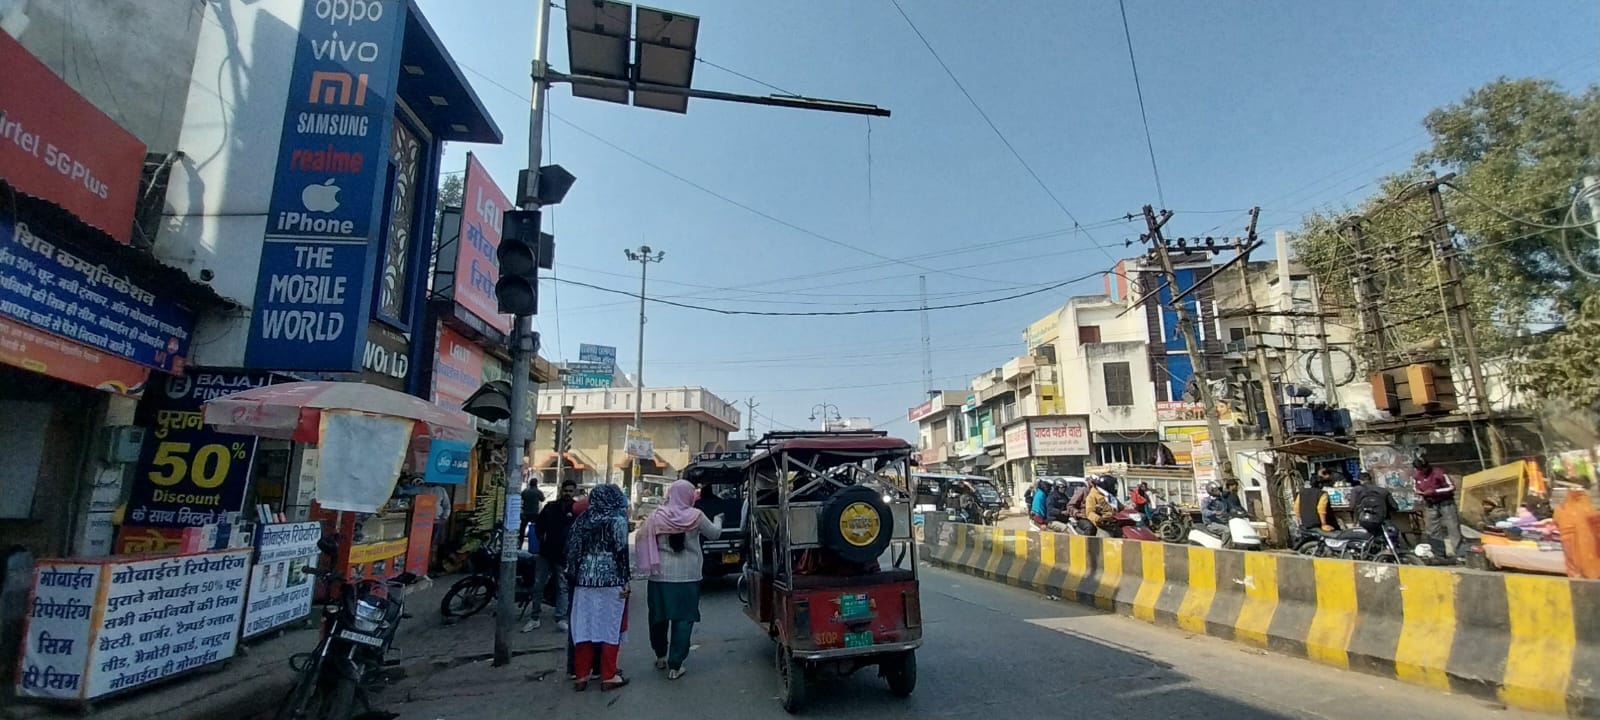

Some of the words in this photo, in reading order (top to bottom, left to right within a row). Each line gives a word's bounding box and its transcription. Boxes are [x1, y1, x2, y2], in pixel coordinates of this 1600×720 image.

[312, 31, 379, 62] vivo
[0, 109, 40, 158] irtel
[297, 112, 369, 137] SAMSUNG
[291, 144, 365, 175] realme
[278, 211, 354, 234] iPhone
[476, 186, 501, 235] LAL
[14, 221, 56, 259] शिव
[16, 256, 37, 277] 50%
[294, 245, 333, 269] THE
[268, 274, 347, 305] MOBILE
[31, 288, 47, 304] की
[66, 302, 78, 317] ही
[128, 324, 139, 340] ही
[51, 316, 62, 332] से
[261, 310, 344, 342] WORLD
[197, 373, 264, 388] BAJAJ
[567, 374, 584, 385] ELHI
[585, 376, 610, 388] POLICE
[1034, 426, 1051, 438] यादव
[1068, 422, 1082, 437] वाले
[152, 489, 221, 505] Discount
[132, 504, 148, 521] के
[149, 510, 174, 523] साथ
[177, 506, 214, 525] मिलते
[182, 555, 246, 576] रिपेयरिंग
[108, 589, 145, 612] पुराने
[201, 580, 223, 594] 50%
[226, 577, 243, 592] छूट
[32, 596, 92, 620] रिपेयरिंग
[104, 611, 136, 629] सभी
[138, 600, 196, 622] कंपनियों
[197, 597, 214, 611] की
[216, 594, 238, 609] सिम
[37, 630, 74, 655] सिम
[21, 665, 39, 689] ही
[42, 665, 80, 690] सिम
[161, 660, 174, 677] ही
